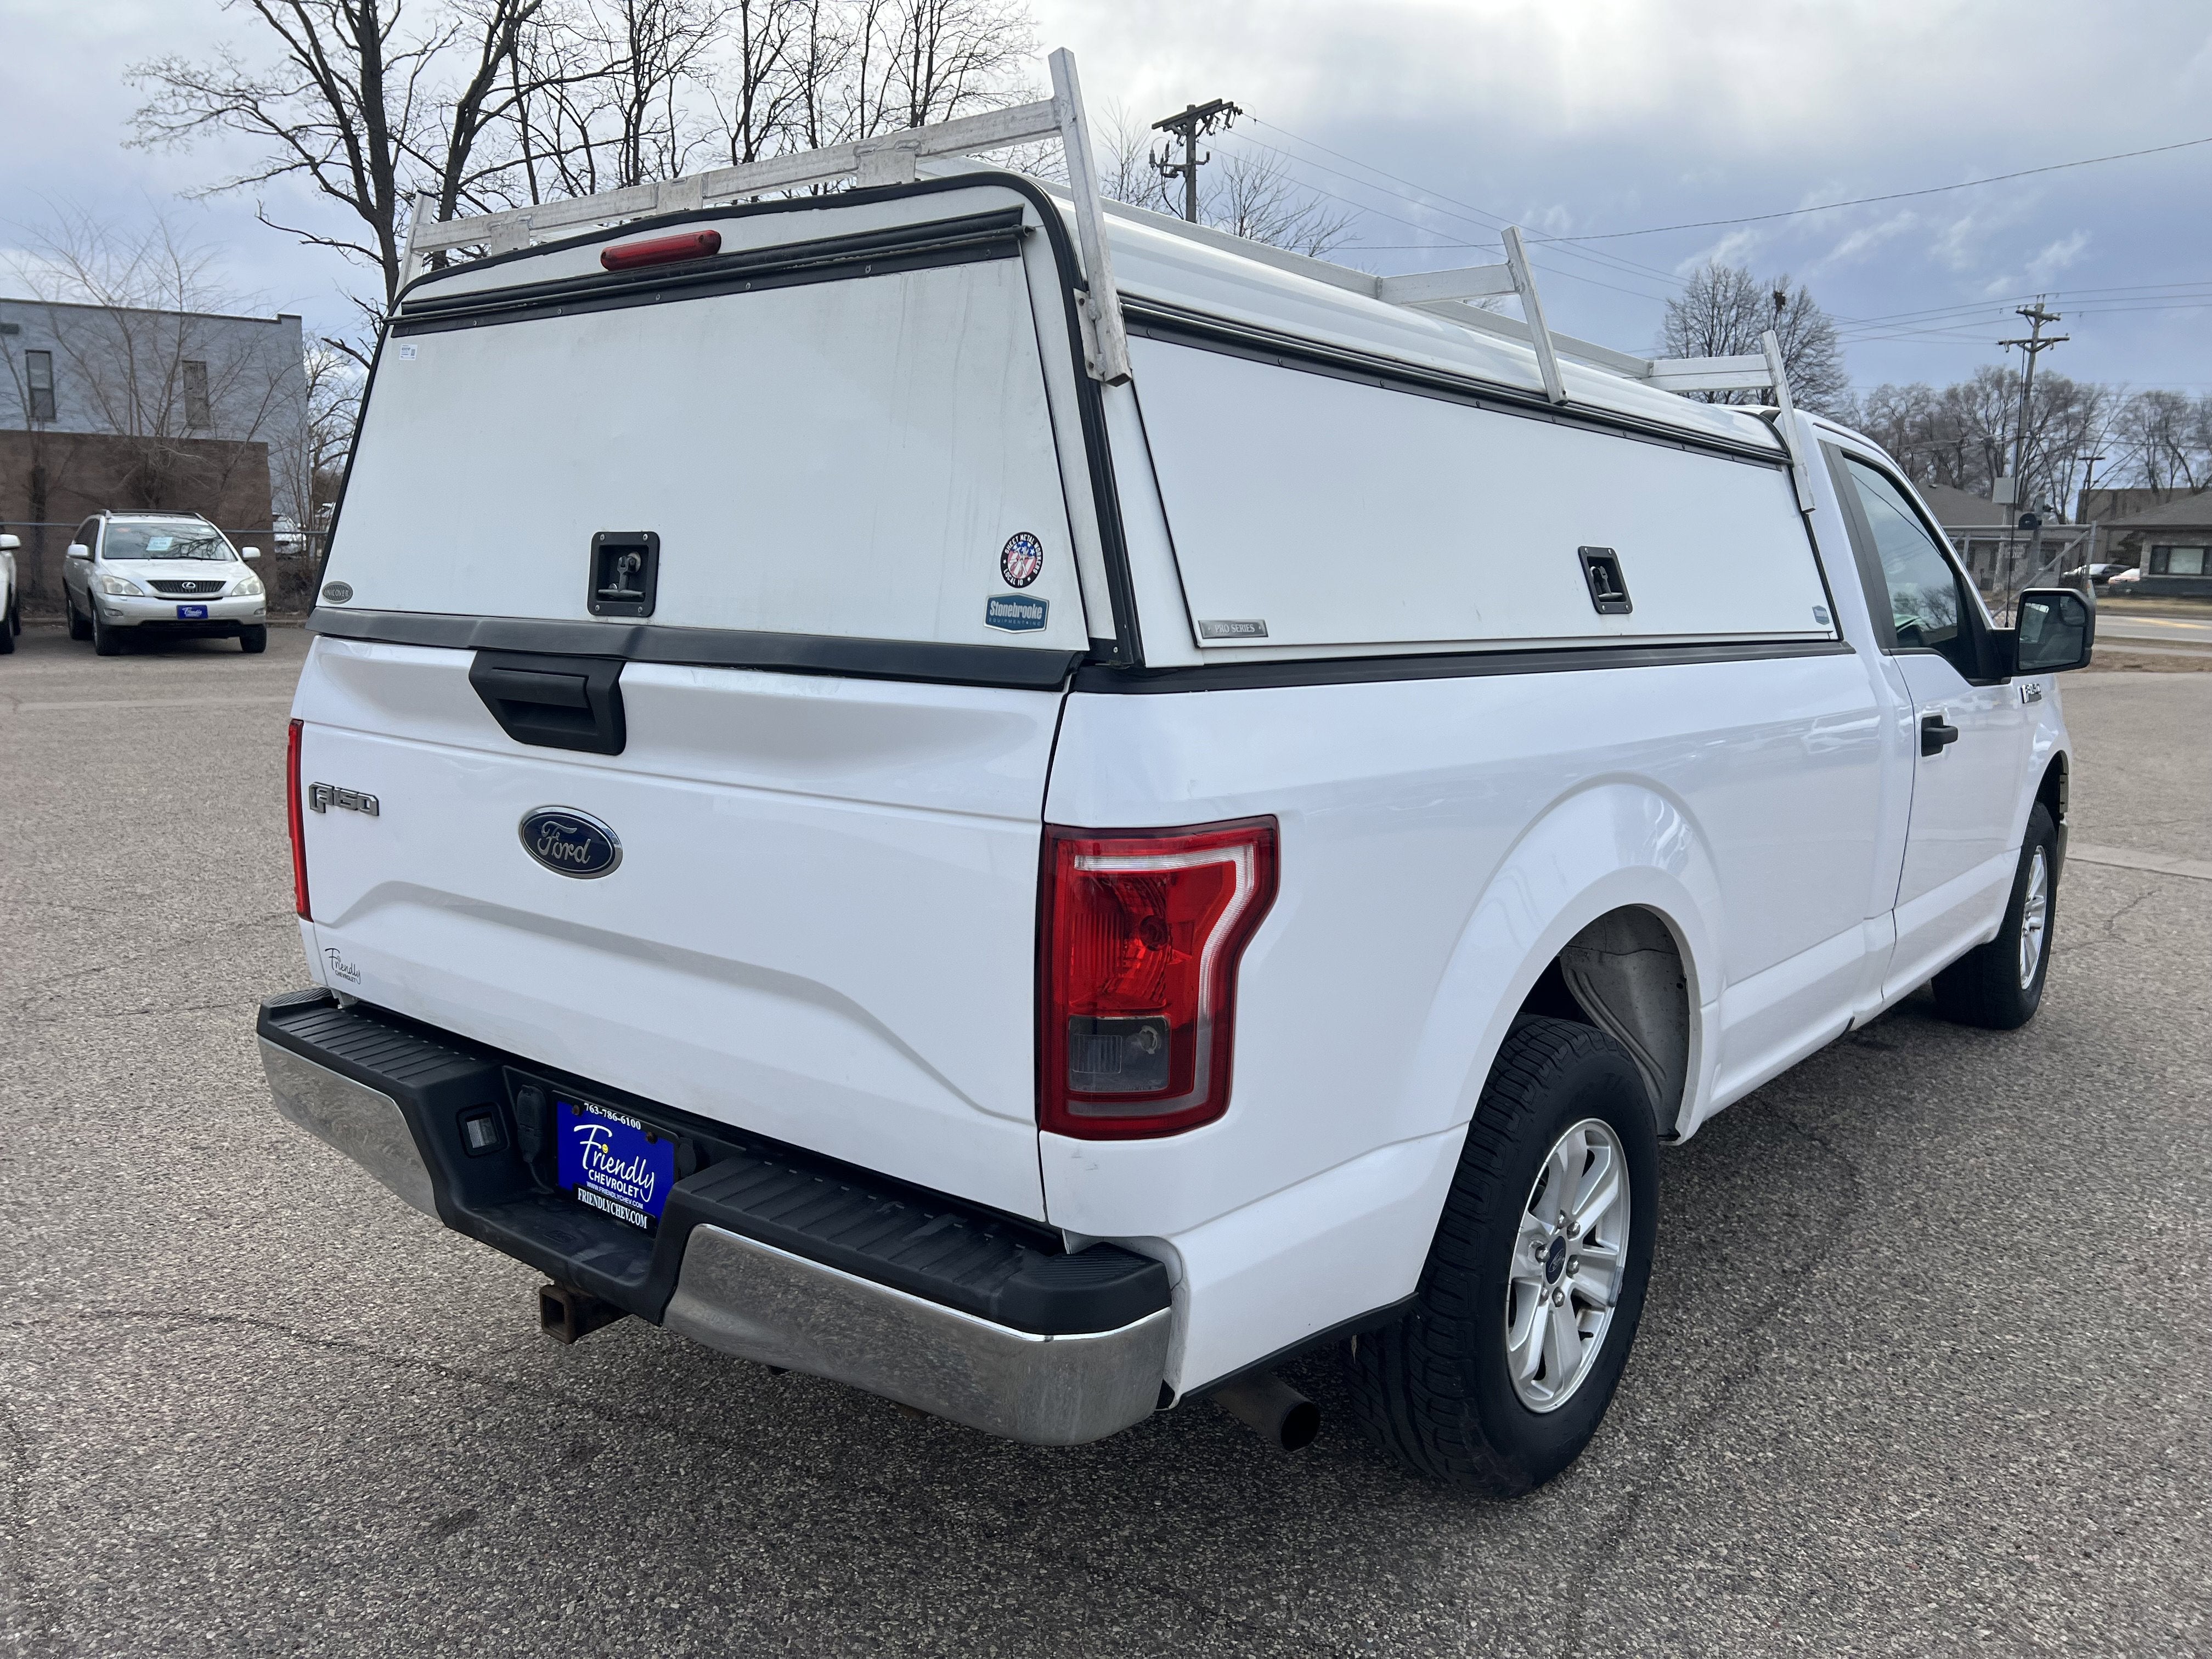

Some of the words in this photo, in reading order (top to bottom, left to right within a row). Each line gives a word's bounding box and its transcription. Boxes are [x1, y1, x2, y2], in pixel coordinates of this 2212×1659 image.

[1005, 536, 1018, 554] SHEET
[1020, 534, 1035, 544] METAL
[1003, 568, 1015, 585] LOCAL
[990, 600, 1043, 620] Stonebrooke
[1215, 624, 1230, 633] PRO
[1231, 624, 1255, 633] SERIES
[537, 821, 591, 865] Ford
[325, 947, 361, 985] Friendly
[335, 970, 356, 983] CHEVROLET
[584, 1102, 641, 1130] 763-786-6100
[574, 1124, 655, 1202] Friendly
[586, 1181, 644, 1210] WWW.FRIENDLYCHEV.COM
[588, 1169, 639, 1198] CHEVROLET
[578, 1188, 647, 1229] FRIENDLYCHEV.COM
